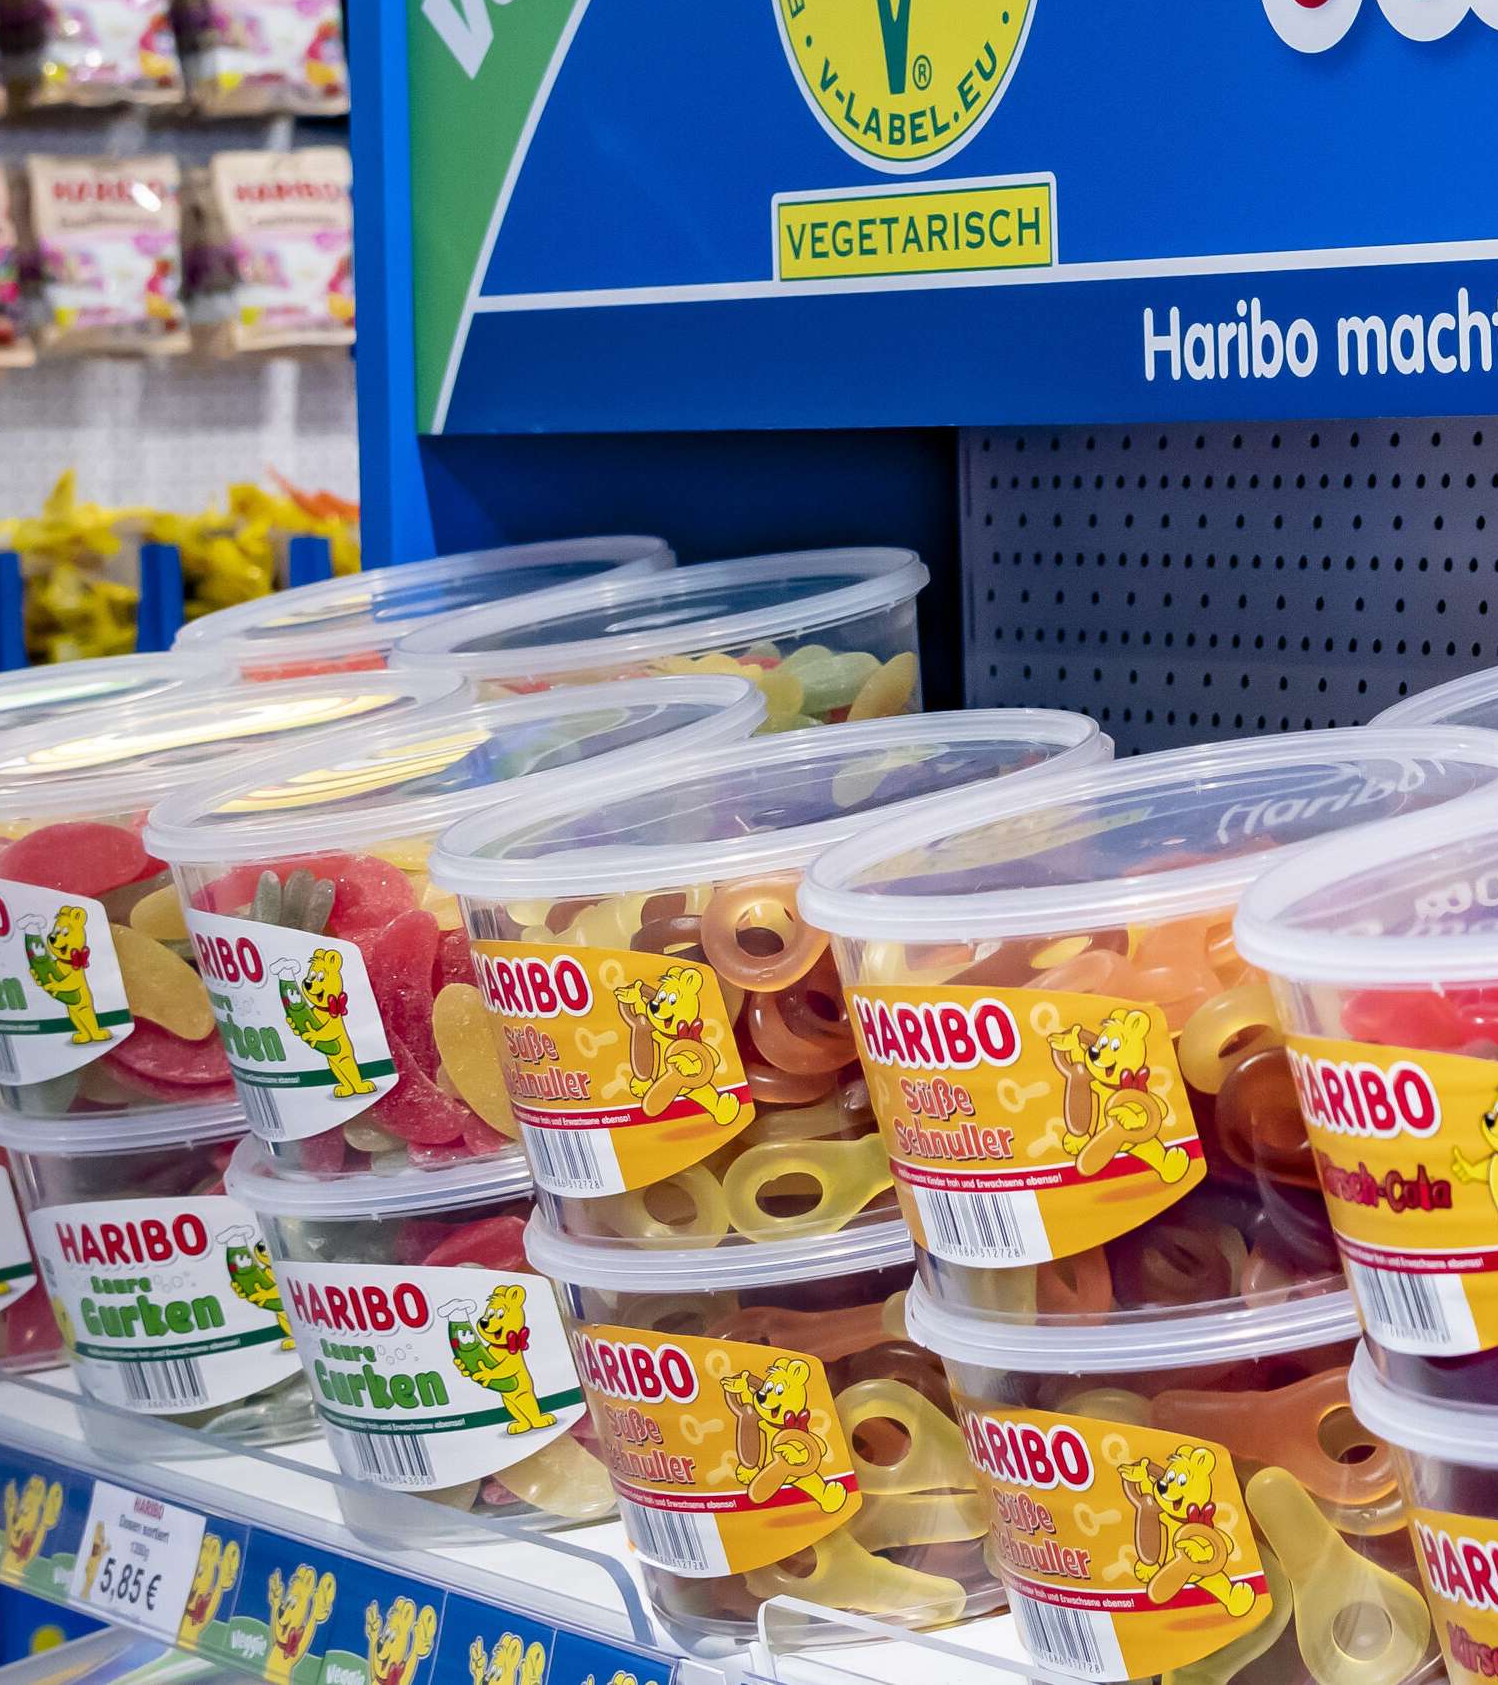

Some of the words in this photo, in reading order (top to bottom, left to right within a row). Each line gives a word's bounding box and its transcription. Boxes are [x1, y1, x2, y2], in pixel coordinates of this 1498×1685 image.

[820, 40, 998, 147] V-LABEL.EU
[786, 208, 1042, 261] VEGETARISCH
[1143, 296, 1319, 382] Haribo
[194, 931, 264, 983] RIBO
[503, 1025, 559, 1065] Süße
[856, 1000, 1016, 1064] HARIBO
[510, 1063, 590, 1101] chnuller
[900, 1077, 976, 1122] Süße
[893, 1117, 1015, 1161] Schnuller
[977, 1177, 1025, 1189] Erwachsene
[1026, 1172, 1063, 1186] ebenso!
[56, 1213, 208, 1265] HARIBO
[80, 1294, 227, 1338] Gurken
[287, 1275, 429, 1332] HARIBO
[314, 1358, 450, 1410] Gurken
[609, 1446, 696, 1484] chnuller
[992, 1486, 1057, 1535] Süße
[100, 1557, 145, 1604] 5,85
[146, 1574, 162, 1611] €
